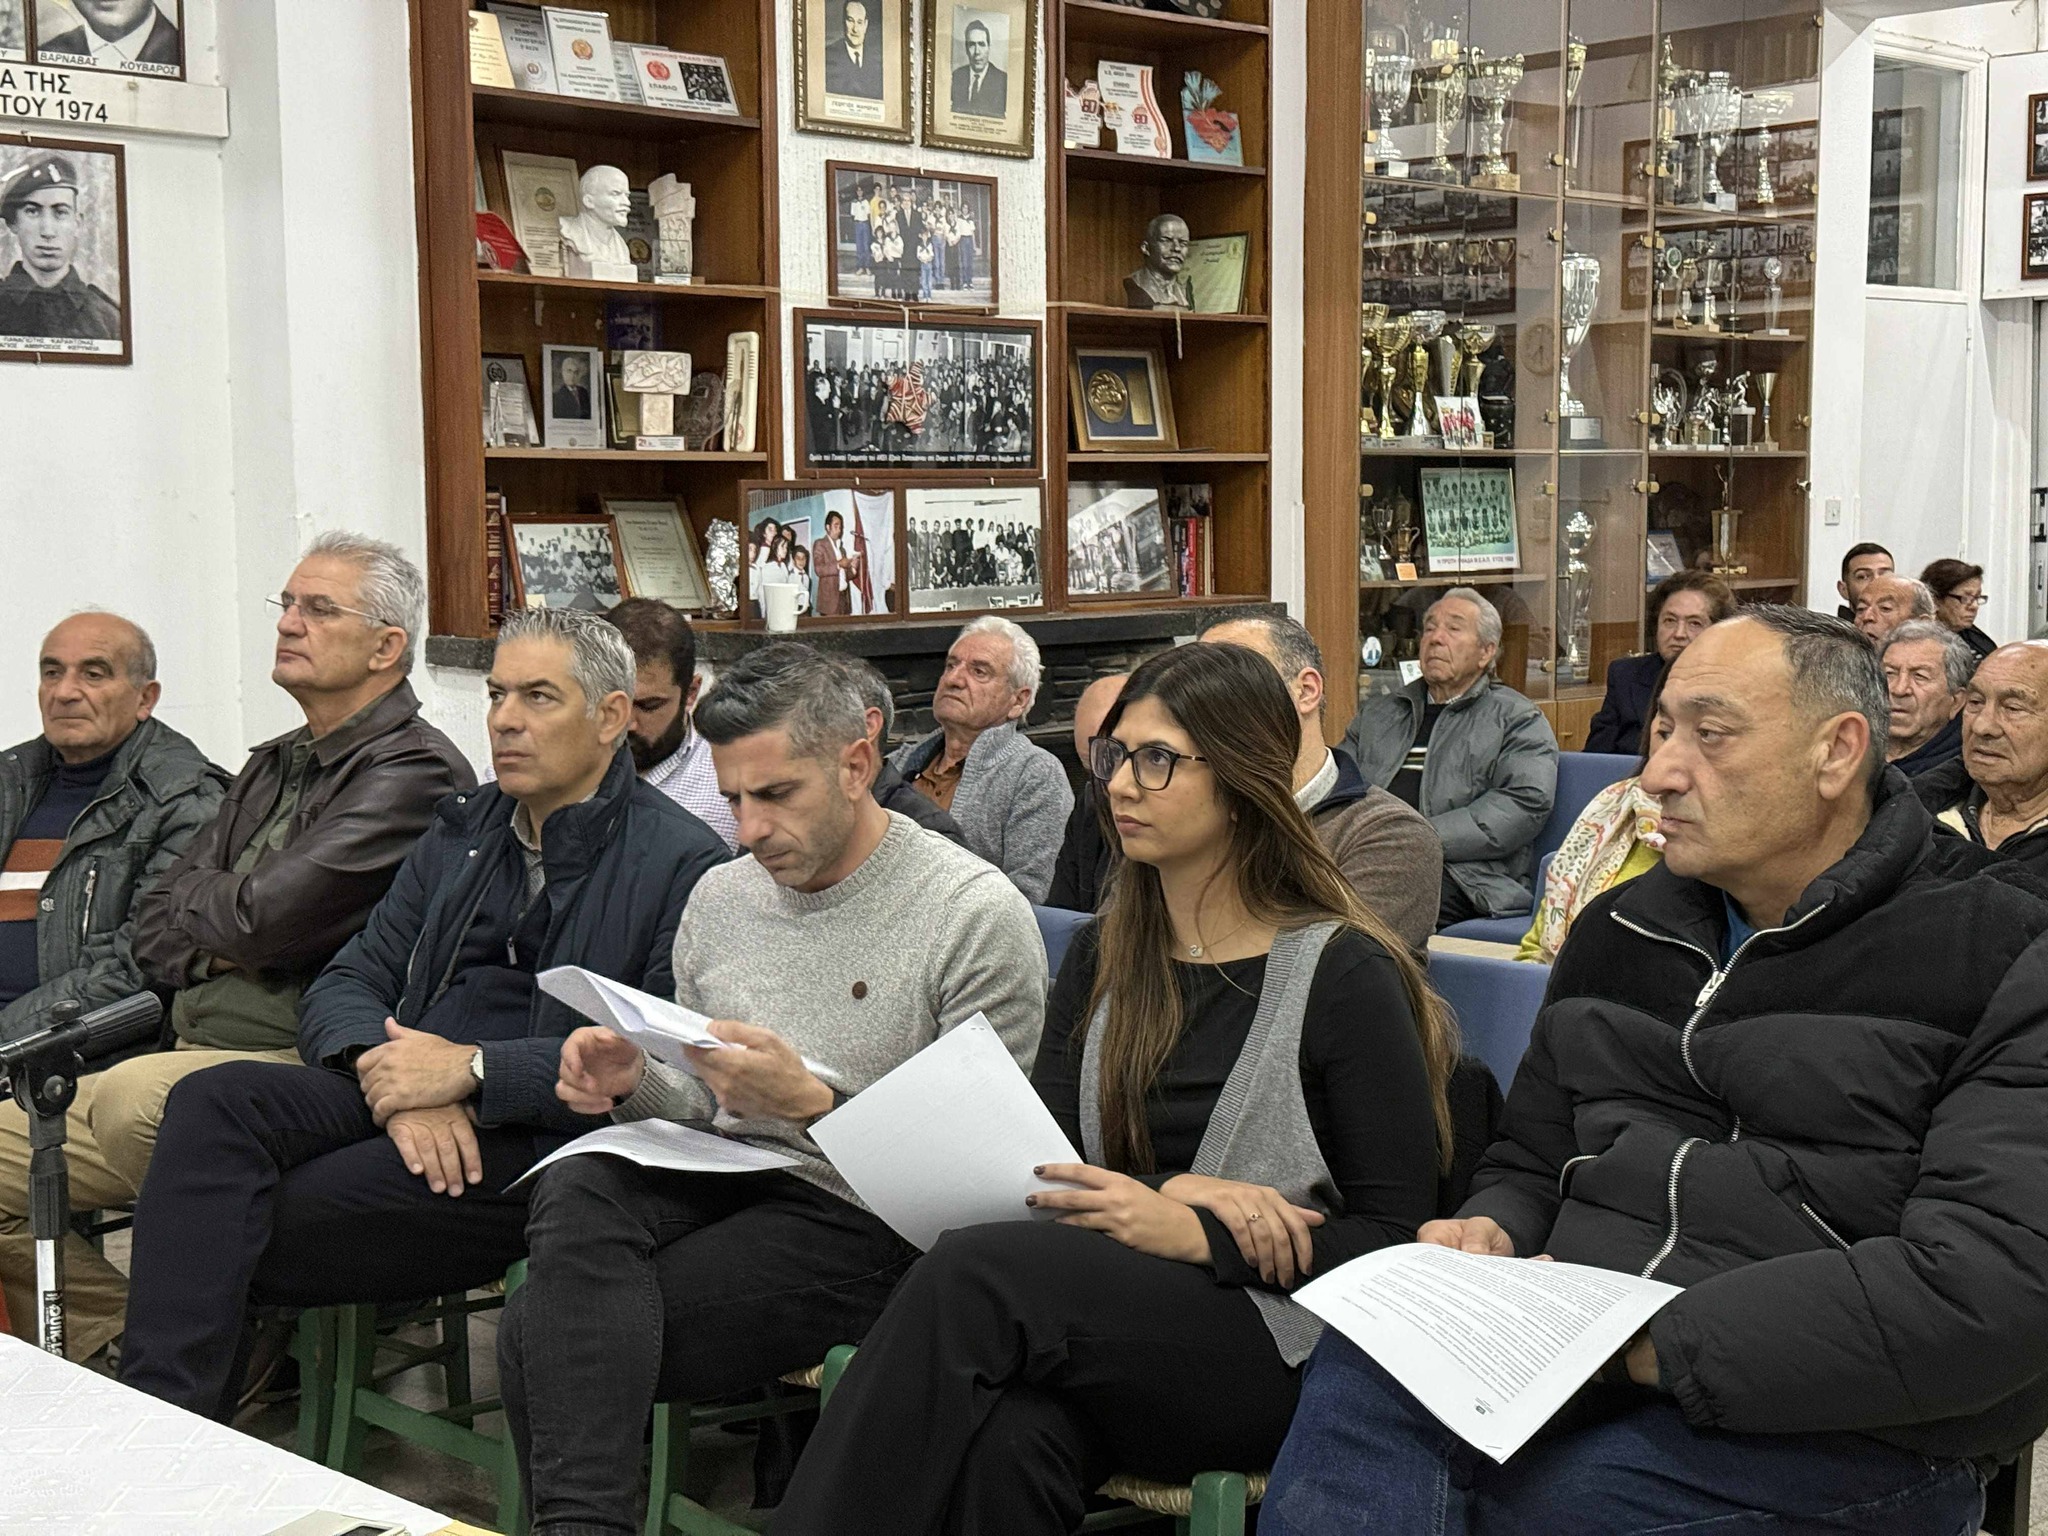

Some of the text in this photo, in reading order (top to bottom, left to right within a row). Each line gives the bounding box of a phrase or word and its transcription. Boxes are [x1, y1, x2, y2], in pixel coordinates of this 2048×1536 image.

[40, 52, 177, 75] ΒΑΡΝΑΒΑΣ ΚΟΥΒΑΡΟΣ
[0, 69, 71, 94] Α ΤΗΣ
[0, 94, 108, 123] ΤΟΥ 1974
